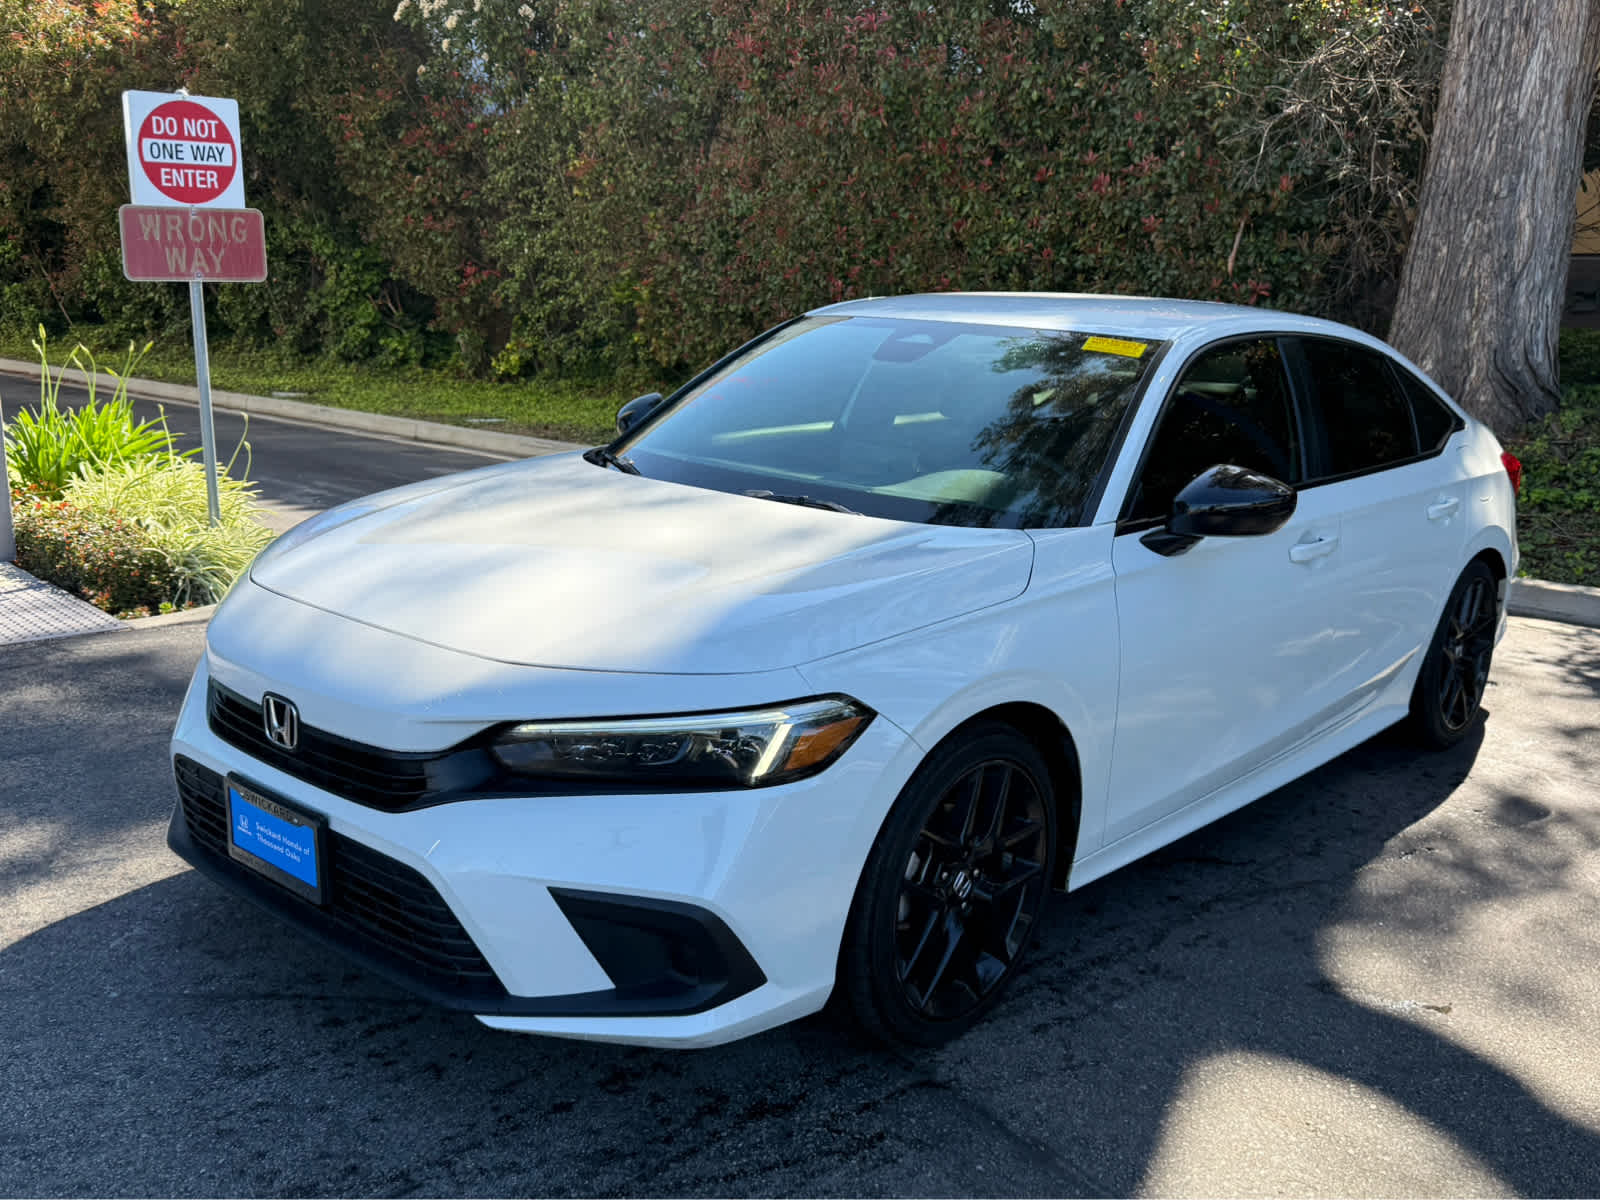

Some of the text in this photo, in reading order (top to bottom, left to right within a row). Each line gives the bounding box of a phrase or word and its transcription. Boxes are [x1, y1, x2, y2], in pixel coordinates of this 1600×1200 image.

[151, 116, 219, 139] DO NOT
[150, 142, 225, 162] ONE WAY
[160, 168, 219, 189] ENTER
[138, 213, 248, 244] WRONG
[165, 247, 225, 274] WAY
[282, 835, 302, 851] Honda
[303, 847, 310, 856] of
[285, 848, 301, 863] Oaks
